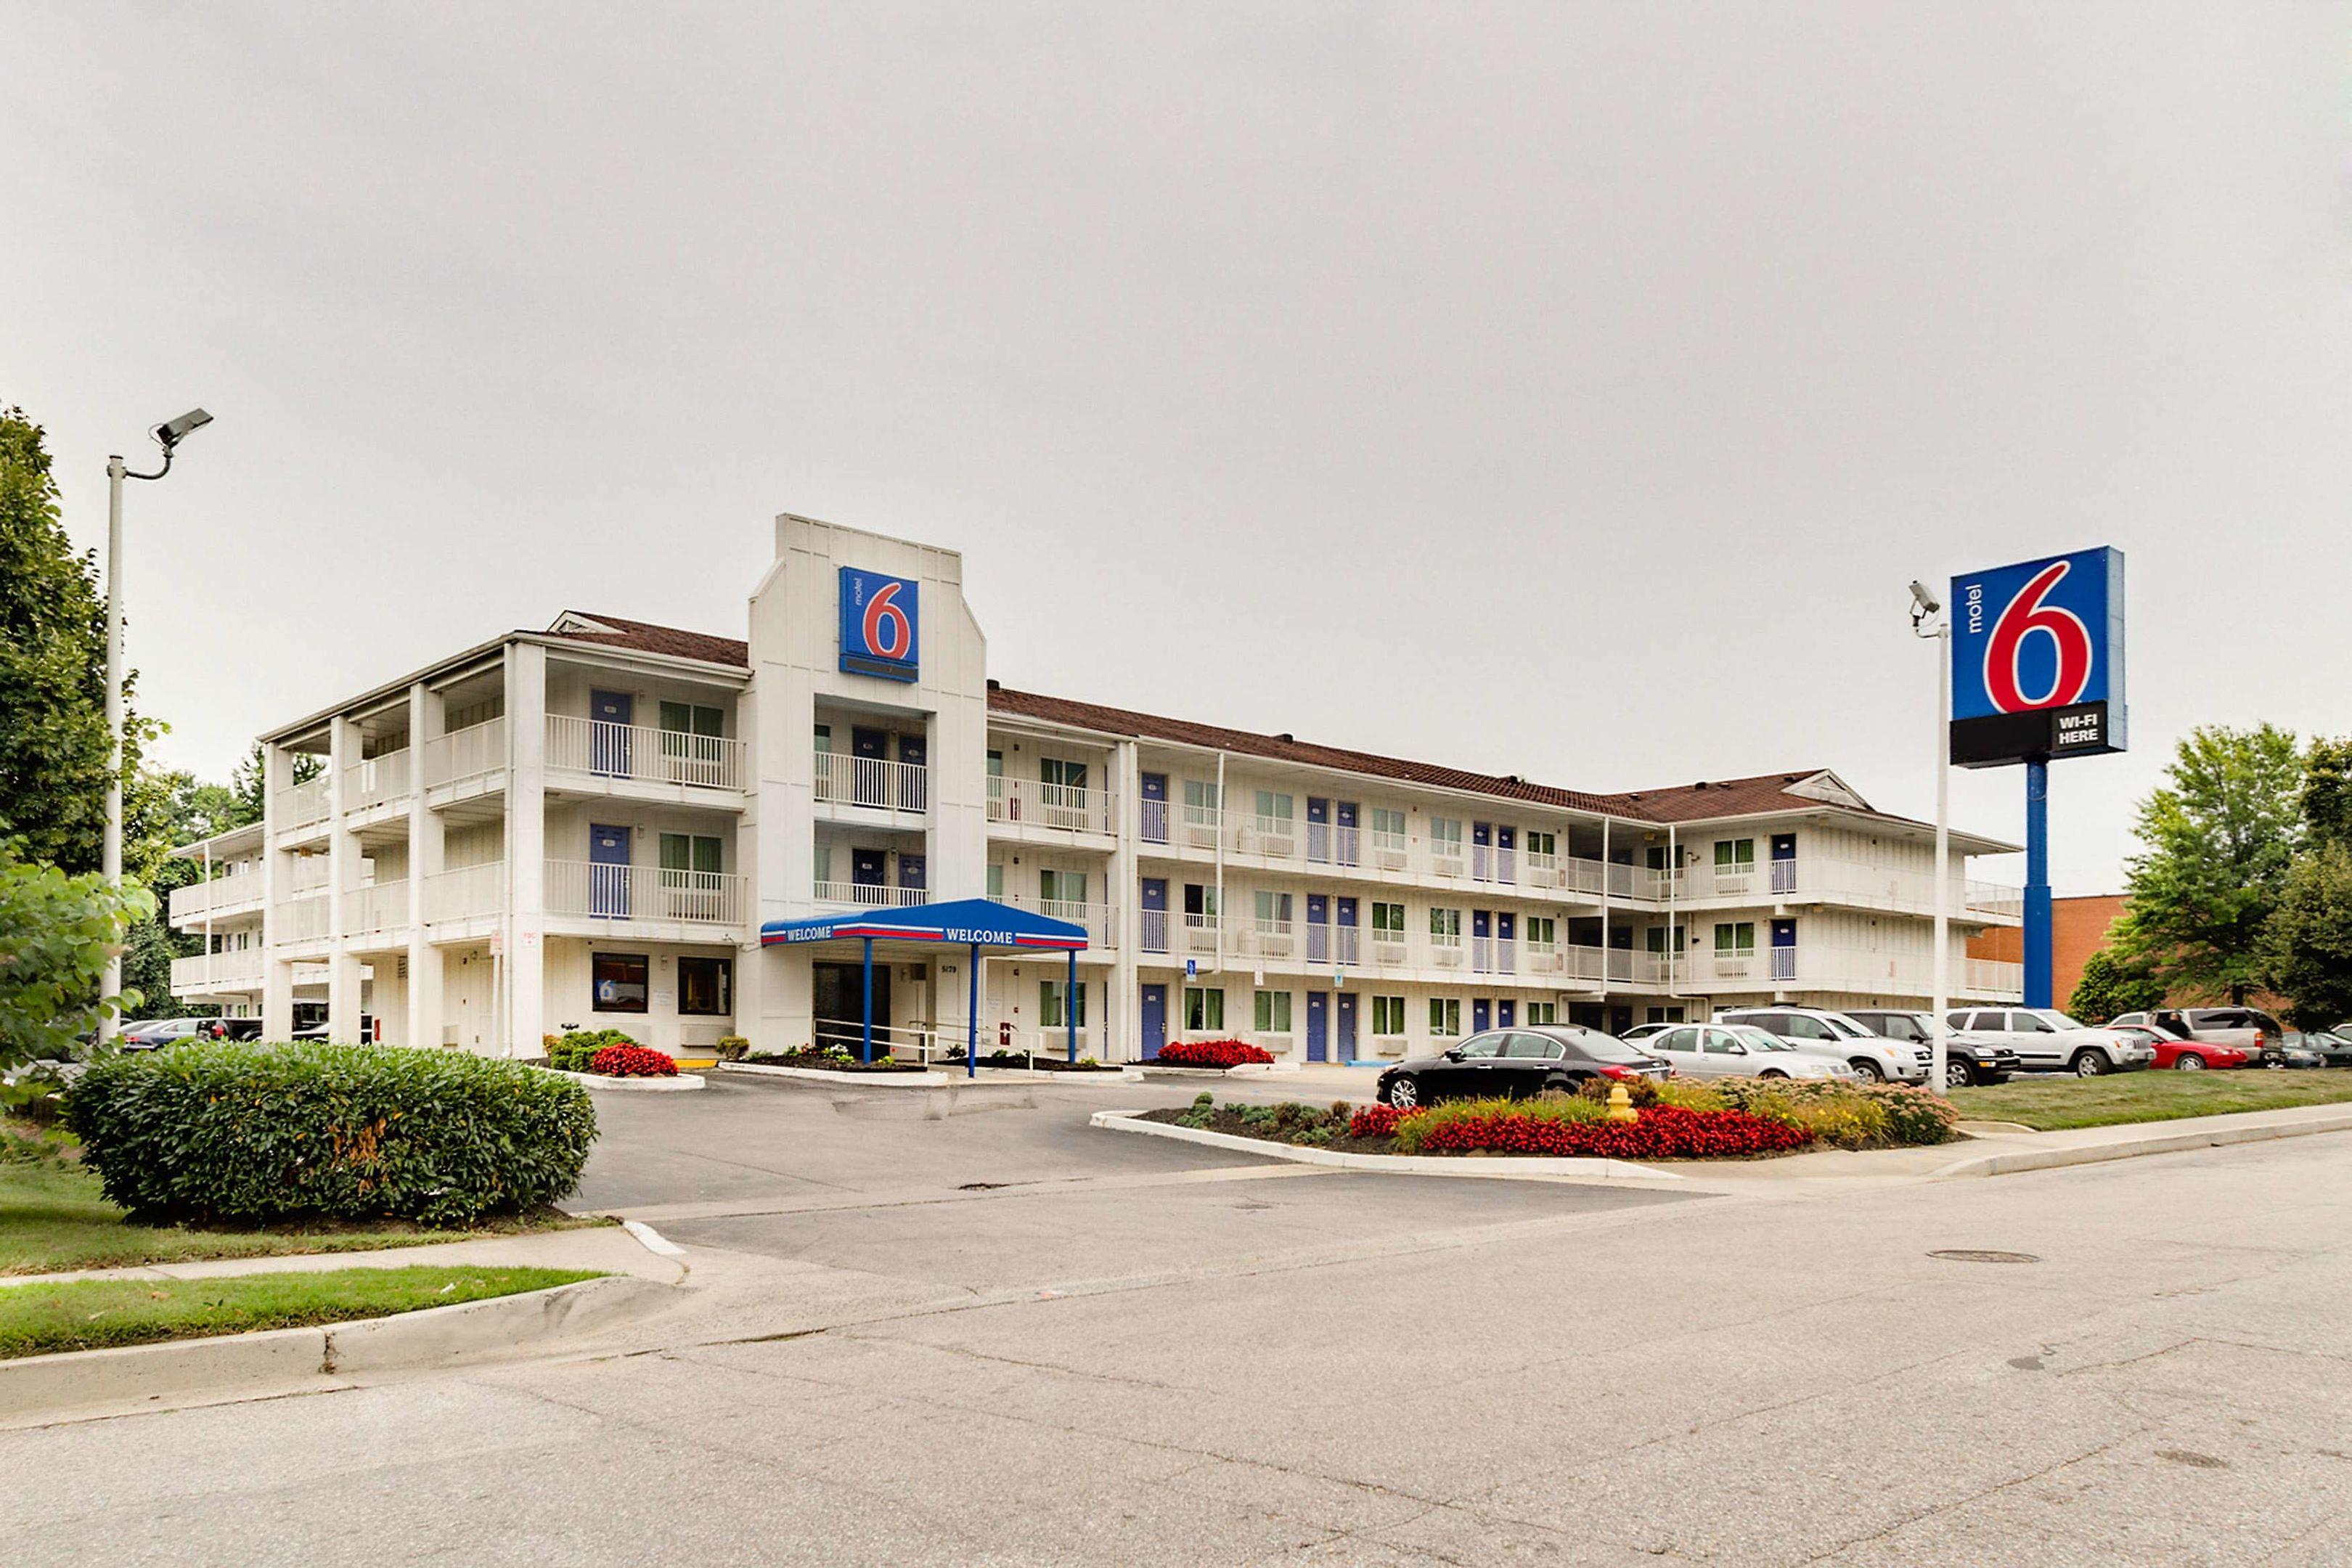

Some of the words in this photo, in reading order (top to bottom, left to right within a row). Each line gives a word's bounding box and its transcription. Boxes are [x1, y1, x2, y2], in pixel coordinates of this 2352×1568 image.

[854, 578, 862, 605] motel
[862, 582, 911, 659] 6
[1965, 584, 1982, 633] motel
[1983, 560, 2093, 714] 6
[2059, 714, 2096, 729] WI-FI
[2059, 728, 2098, 743] HERE
[787, 926, 831, 941] WELCOME
[947, 928, 1012, 944] WELCOME
